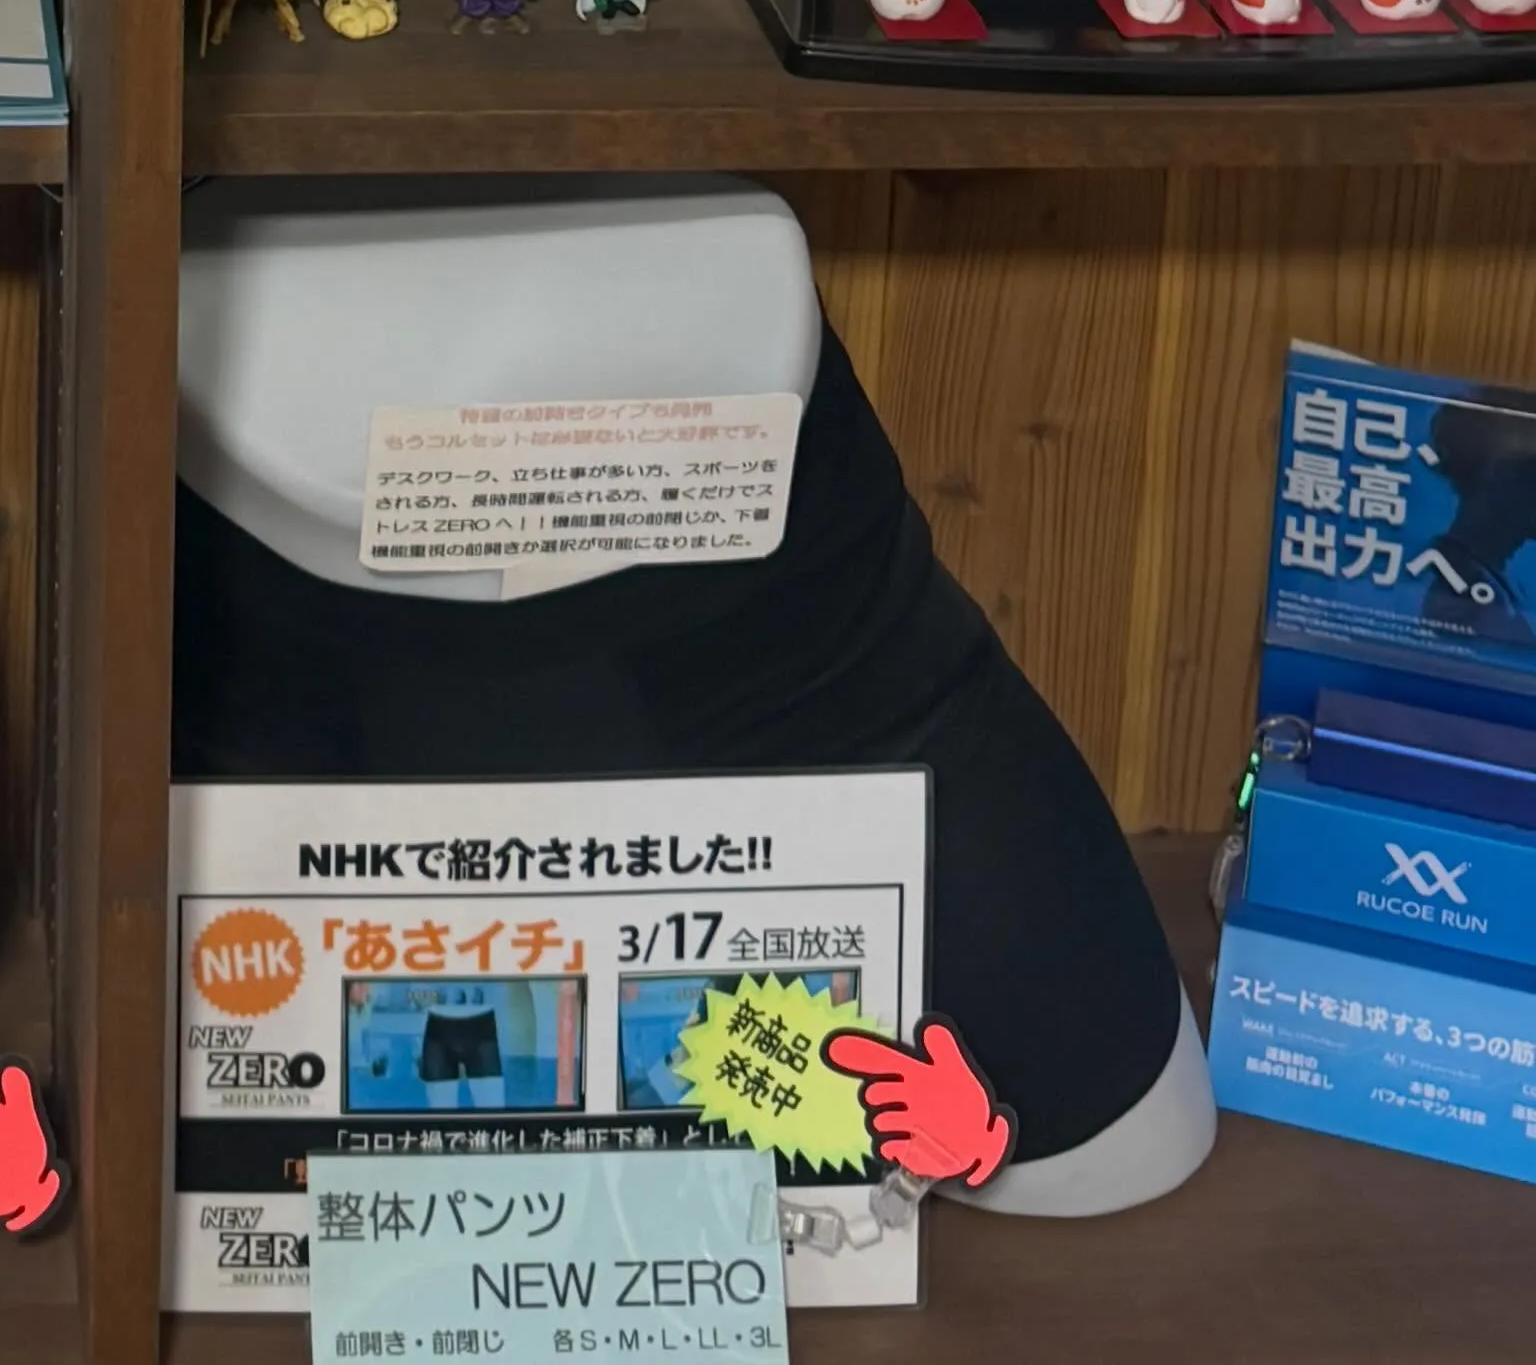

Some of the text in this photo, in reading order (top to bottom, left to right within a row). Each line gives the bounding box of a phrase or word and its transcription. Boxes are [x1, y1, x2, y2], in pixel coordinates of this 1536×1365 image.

[1292, 388, 1441, 467] 自己、
[1281, 449, 1412, 527] 最高
[1279, 515, 1495, 606] 出力へ。
[1357, 890, 1489, 935] RUCOE RUN
[199, 939, 298, 986] NHK
[319, 912, 866, 974] 「あさイチ」 3/17 全国放送
[188, 1025, 254, 1050] NEW
[725, 998, 812, 1074] 新商品
[207, 1051, 326, 1090] ZERO
[714, 1049, 803, 1118] 発売中
[316, 1188, 566, 1245] 整体パンツ
[472, 1257, 767, 1312] NEW ZERO
[334, 1330, 505, 1358] 前開き・前閉じ
